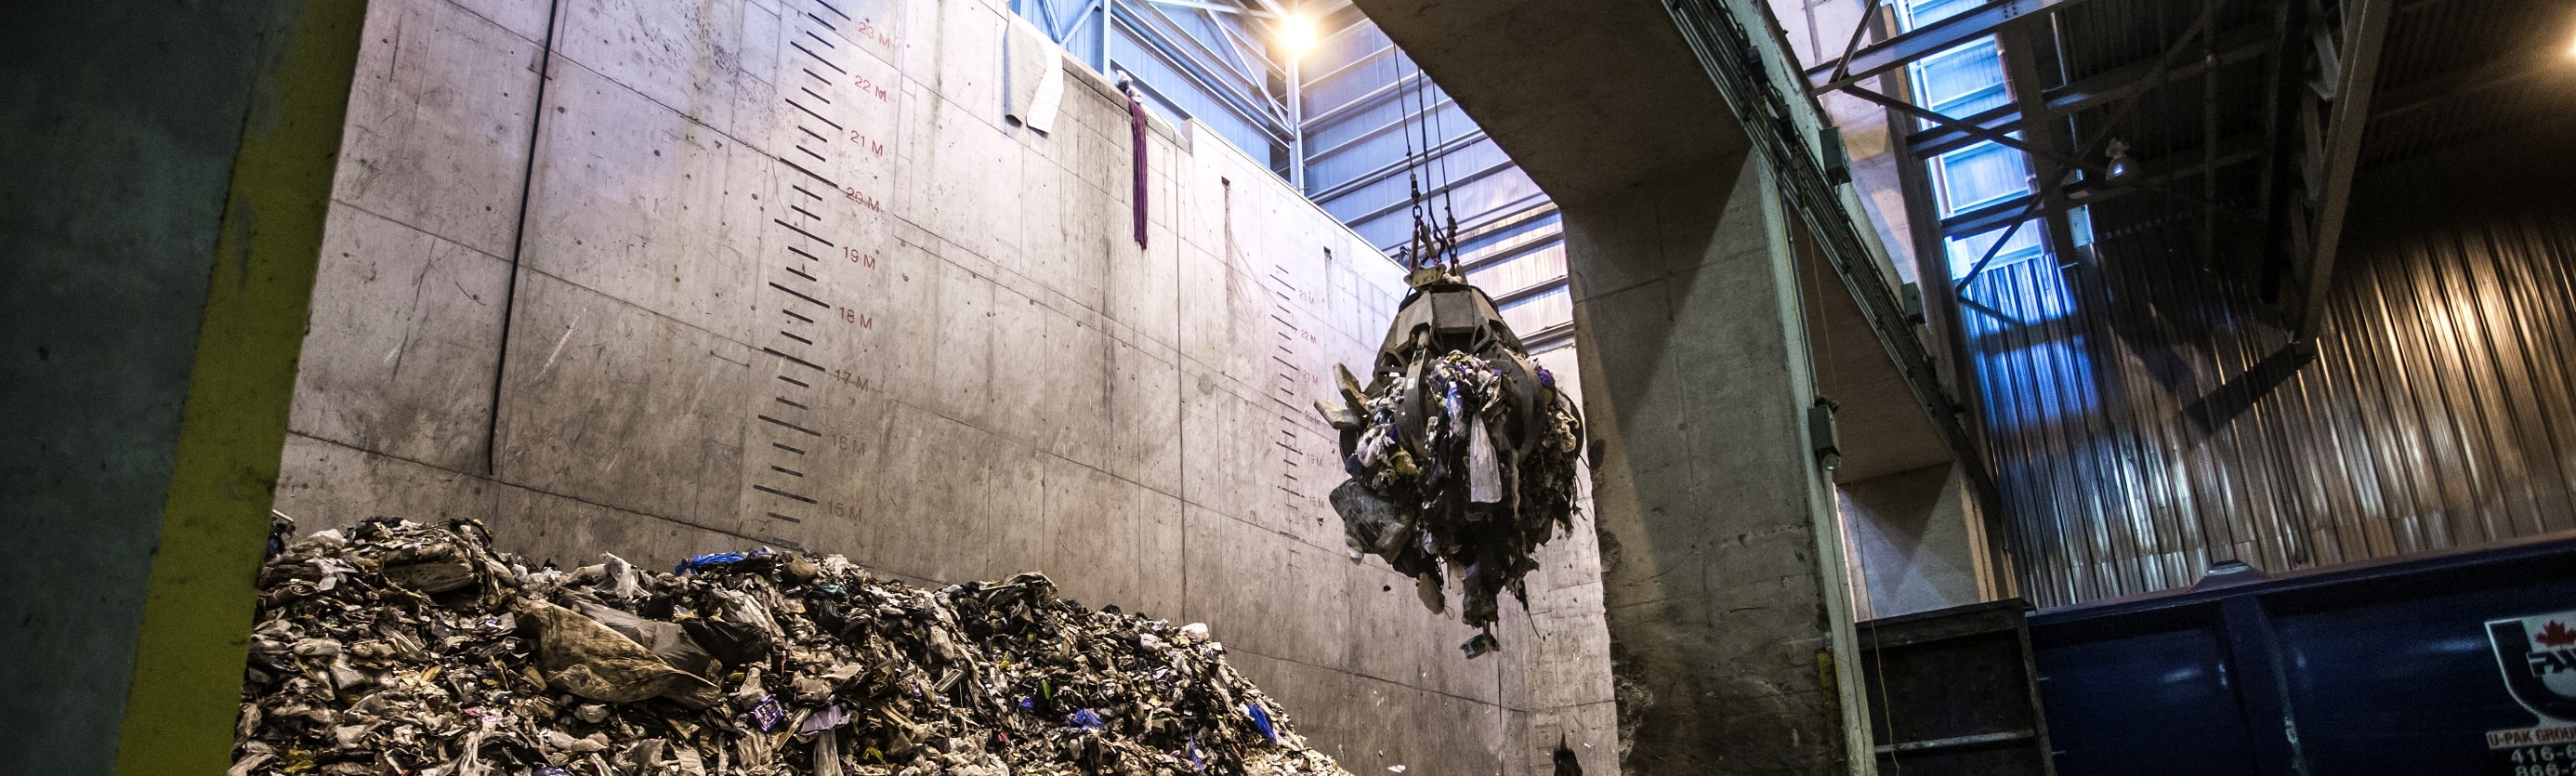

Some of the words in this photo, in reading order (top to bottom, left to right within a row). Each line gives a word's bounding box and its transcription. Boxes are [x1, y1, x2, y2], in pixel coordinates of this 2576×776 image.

[858, 21, 874, 39] 23
[878, 33, 890, 49] M
[854, 75, 871, 93] 22
[875, 85, 887, 102] M
[850, 130, 865, 147] 21
[872, 140, 883, 156] M
[846, 187, 863, 204] 20
[868, 196, 879, 213] M
[843, 246, 859, 263] 19
[863, 254, 875, 270] M
[839, 307, 855, 323] 18
[860, 314, 872, 330] M
[835, 369, 851, 384] 17
[857, 375, 869, 392] M
[832, 435, 848, 451] 16
[853, 440, 865, 455] M
[827, 500, 844, 517] 15
[849, 505, 861, 521] M
[2489, 730, 2531, 747] U-PAK
